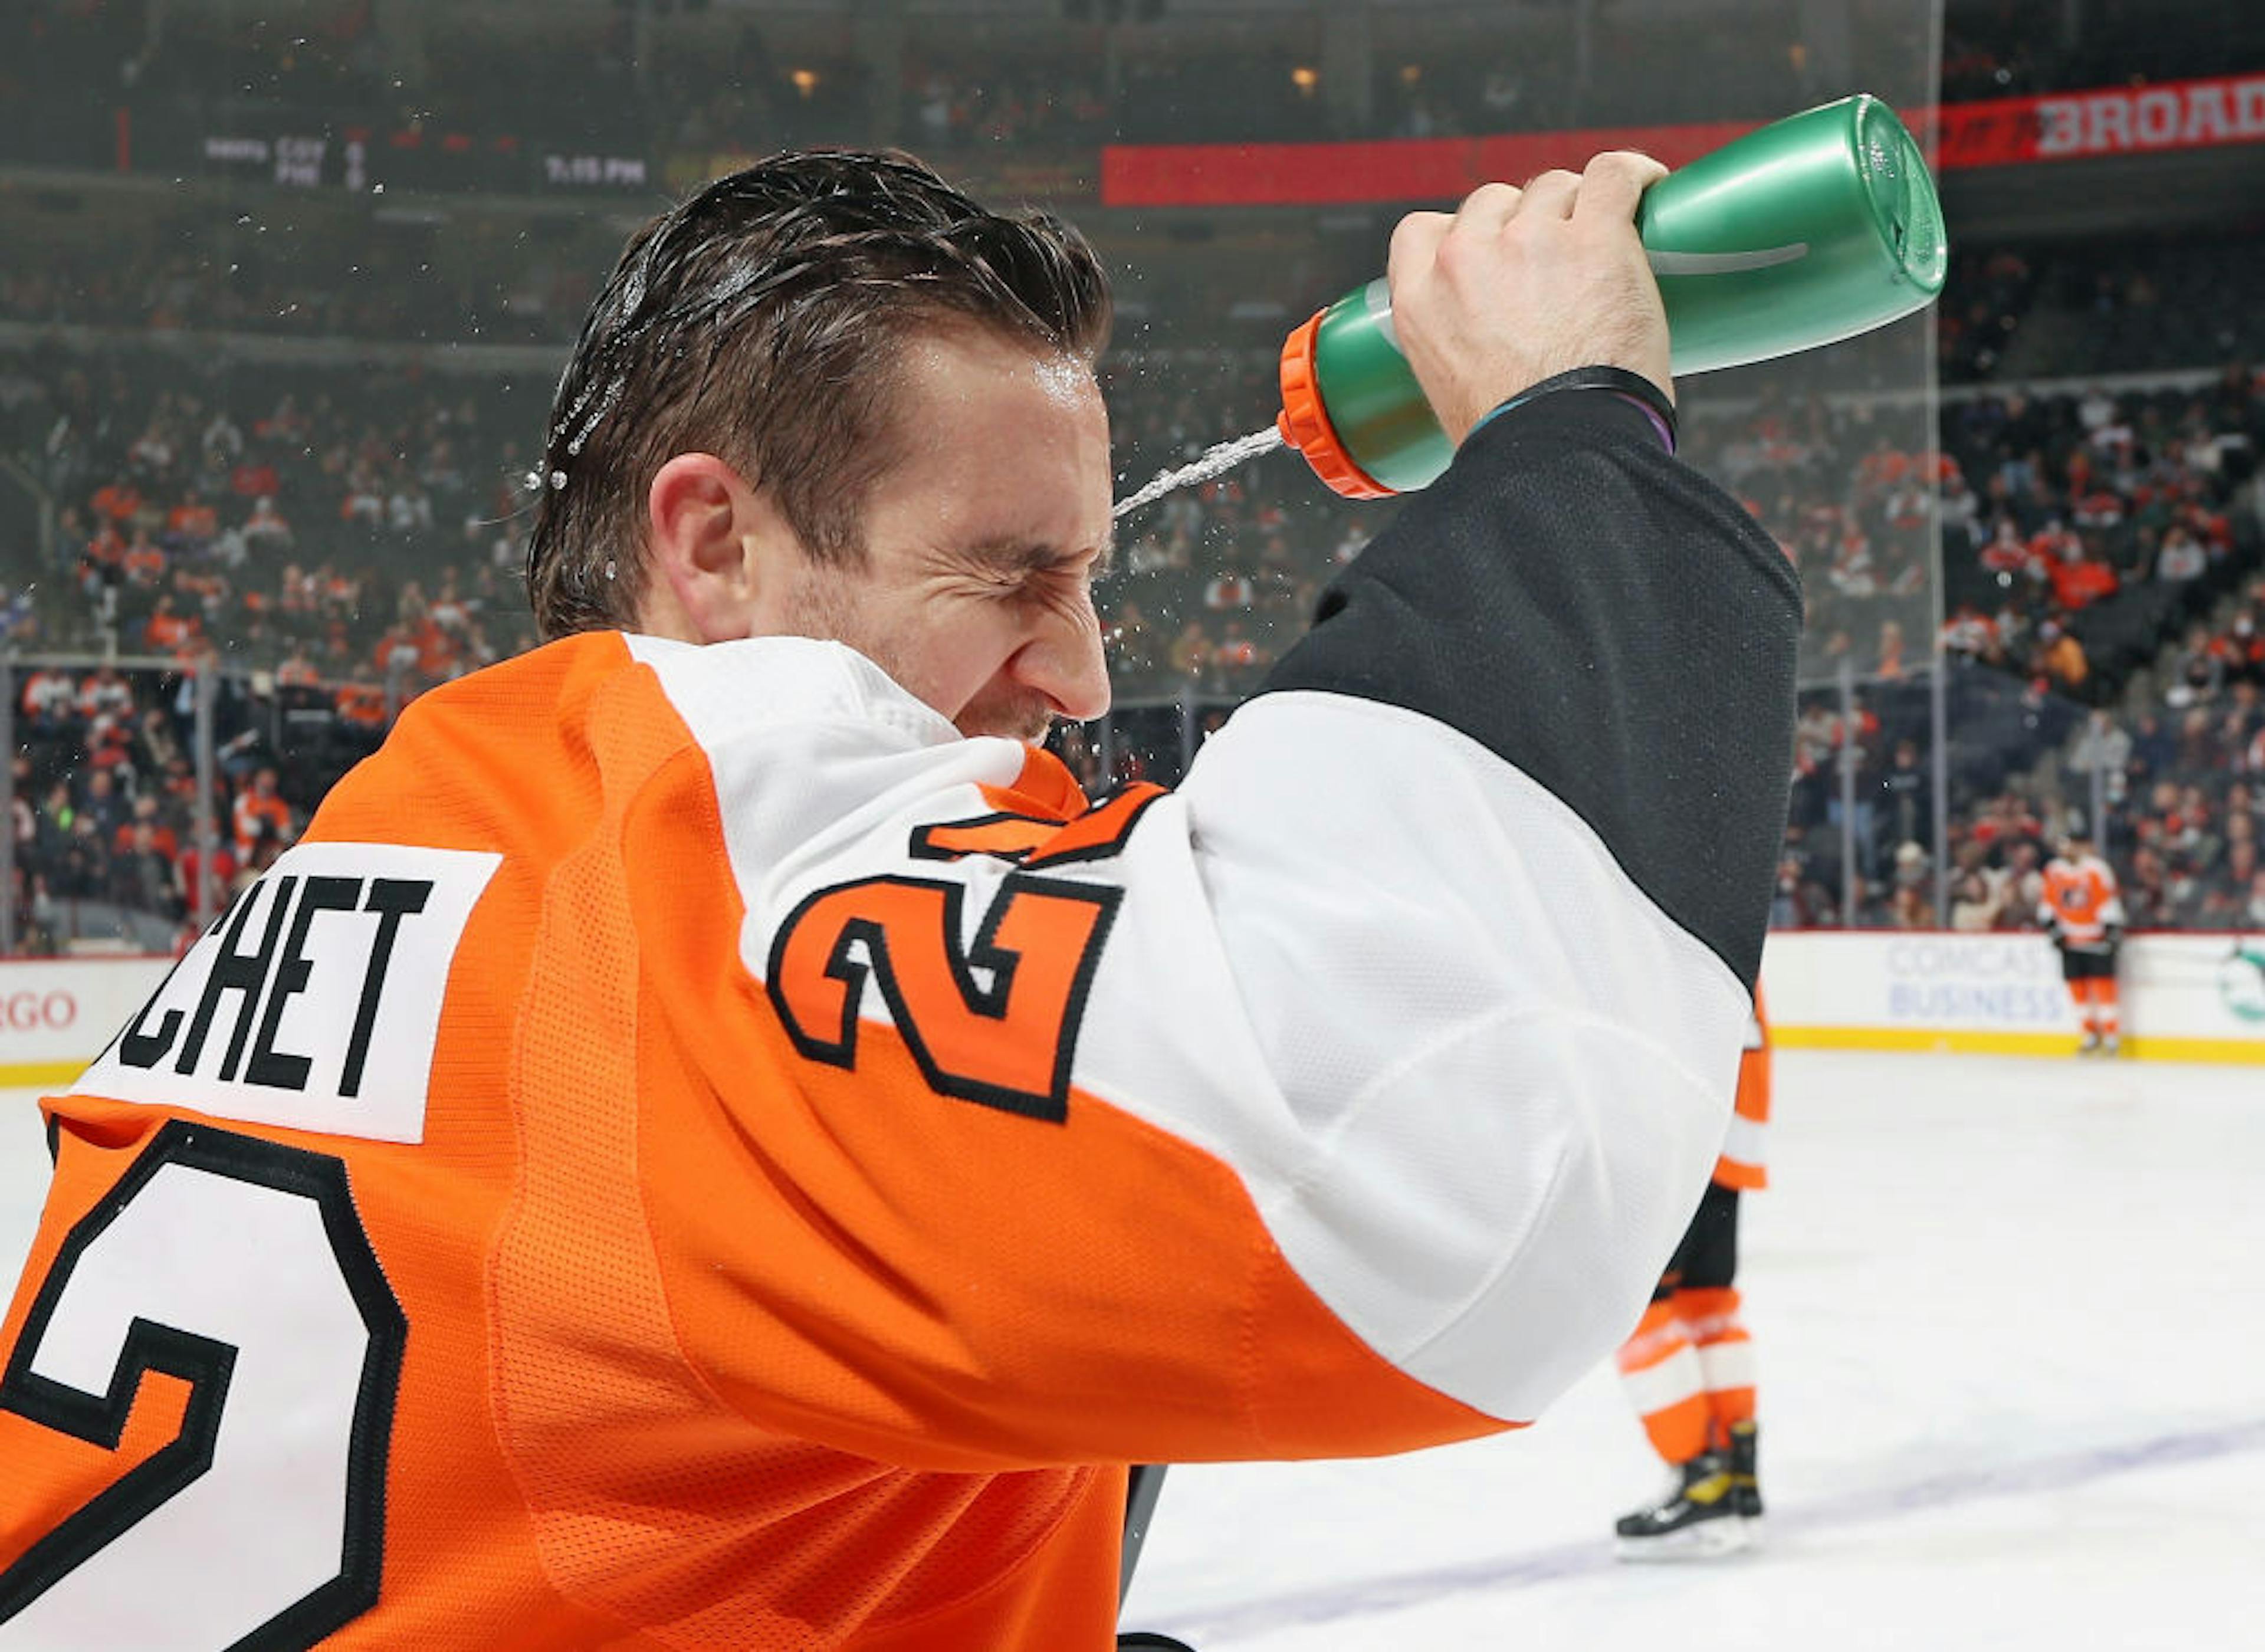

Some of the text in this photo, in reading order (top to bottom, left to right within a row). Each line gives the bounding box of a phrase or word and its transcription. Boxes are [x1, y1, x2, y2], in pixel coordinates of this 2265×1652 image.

[2037, 79, 2265, 152] BROAD
[90, 875, 435, 1099] CHET
[1889, 984, 2061, 1020] BUSINESS
